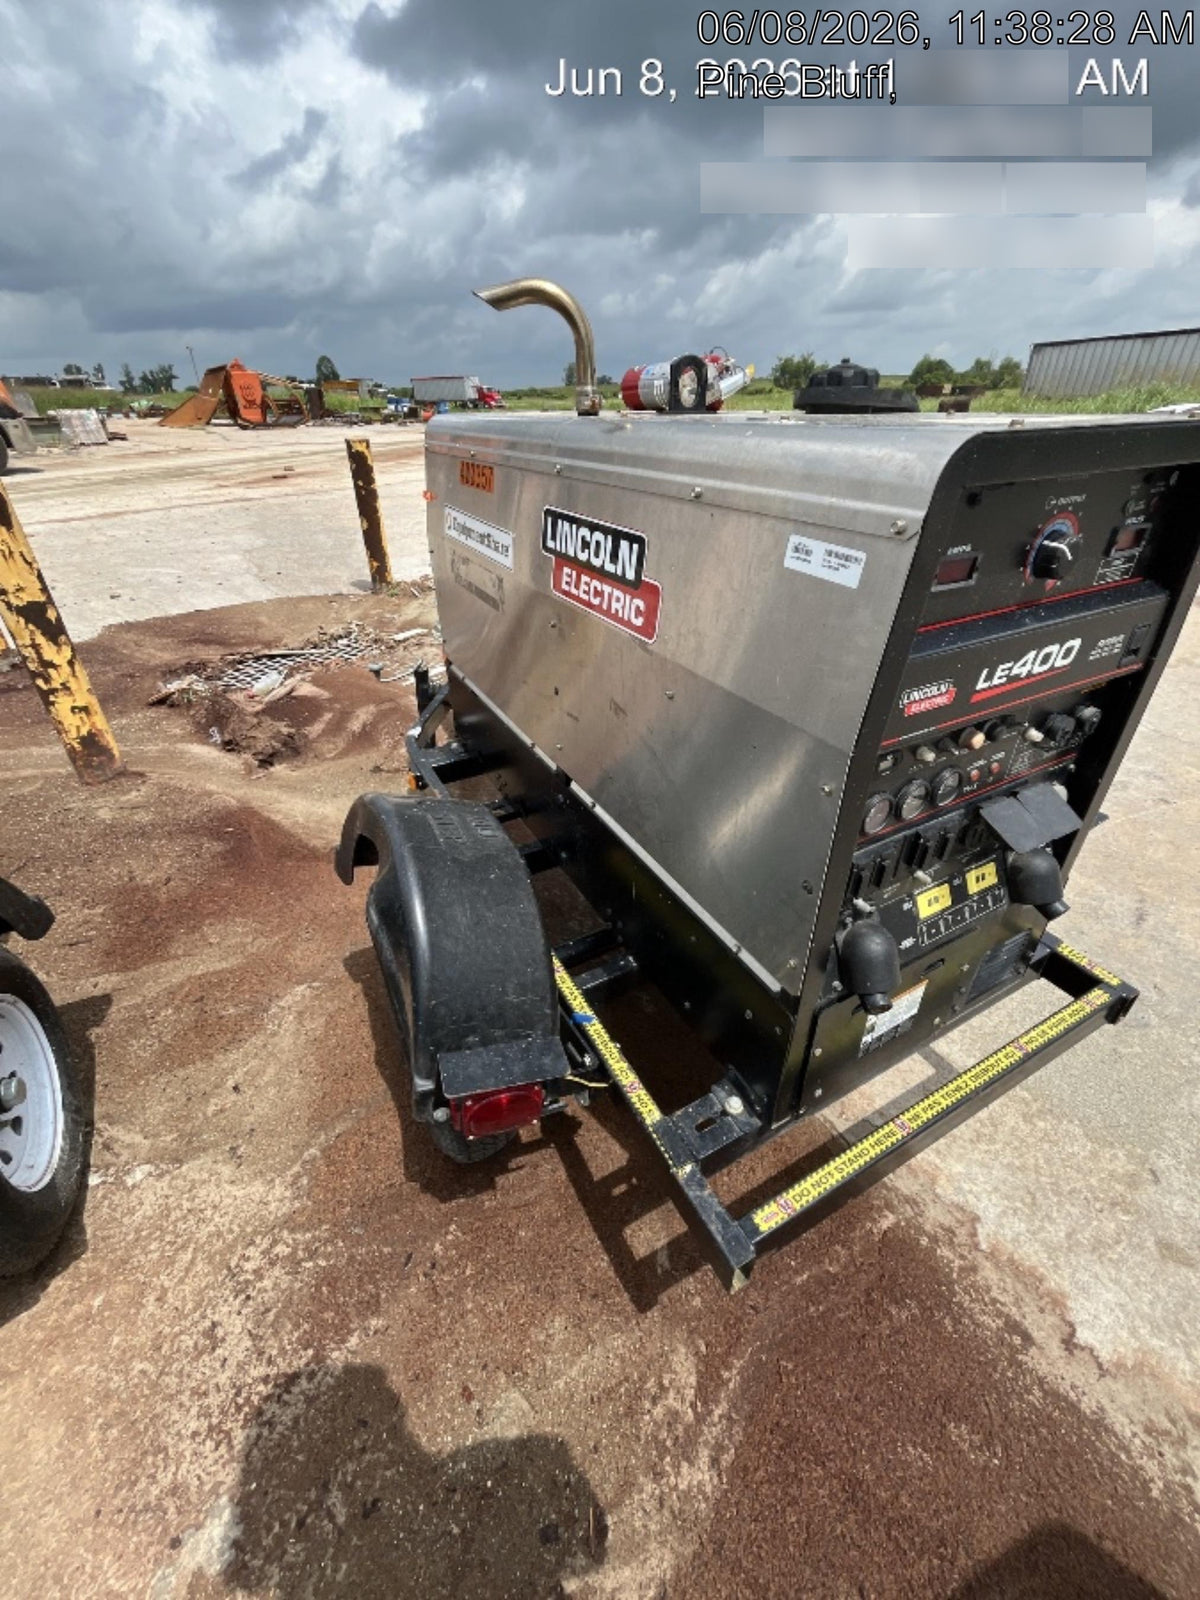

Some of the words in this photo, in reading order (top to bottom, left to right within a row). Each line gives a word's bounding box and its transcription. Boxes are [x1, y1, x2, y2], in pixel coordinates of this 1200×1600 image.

[546, 516, 639, 581] LINCOLN
[562, 566, 646, 626] ELECTRIC
[975, 638, 1082, 691] LE400
[791, 1185, 811, 1204] DO
[809, 1169, 835, 1192] NOT
[832, 1144, 871, 1176] STAND
[868, 1125, 899, 1151] HERE
